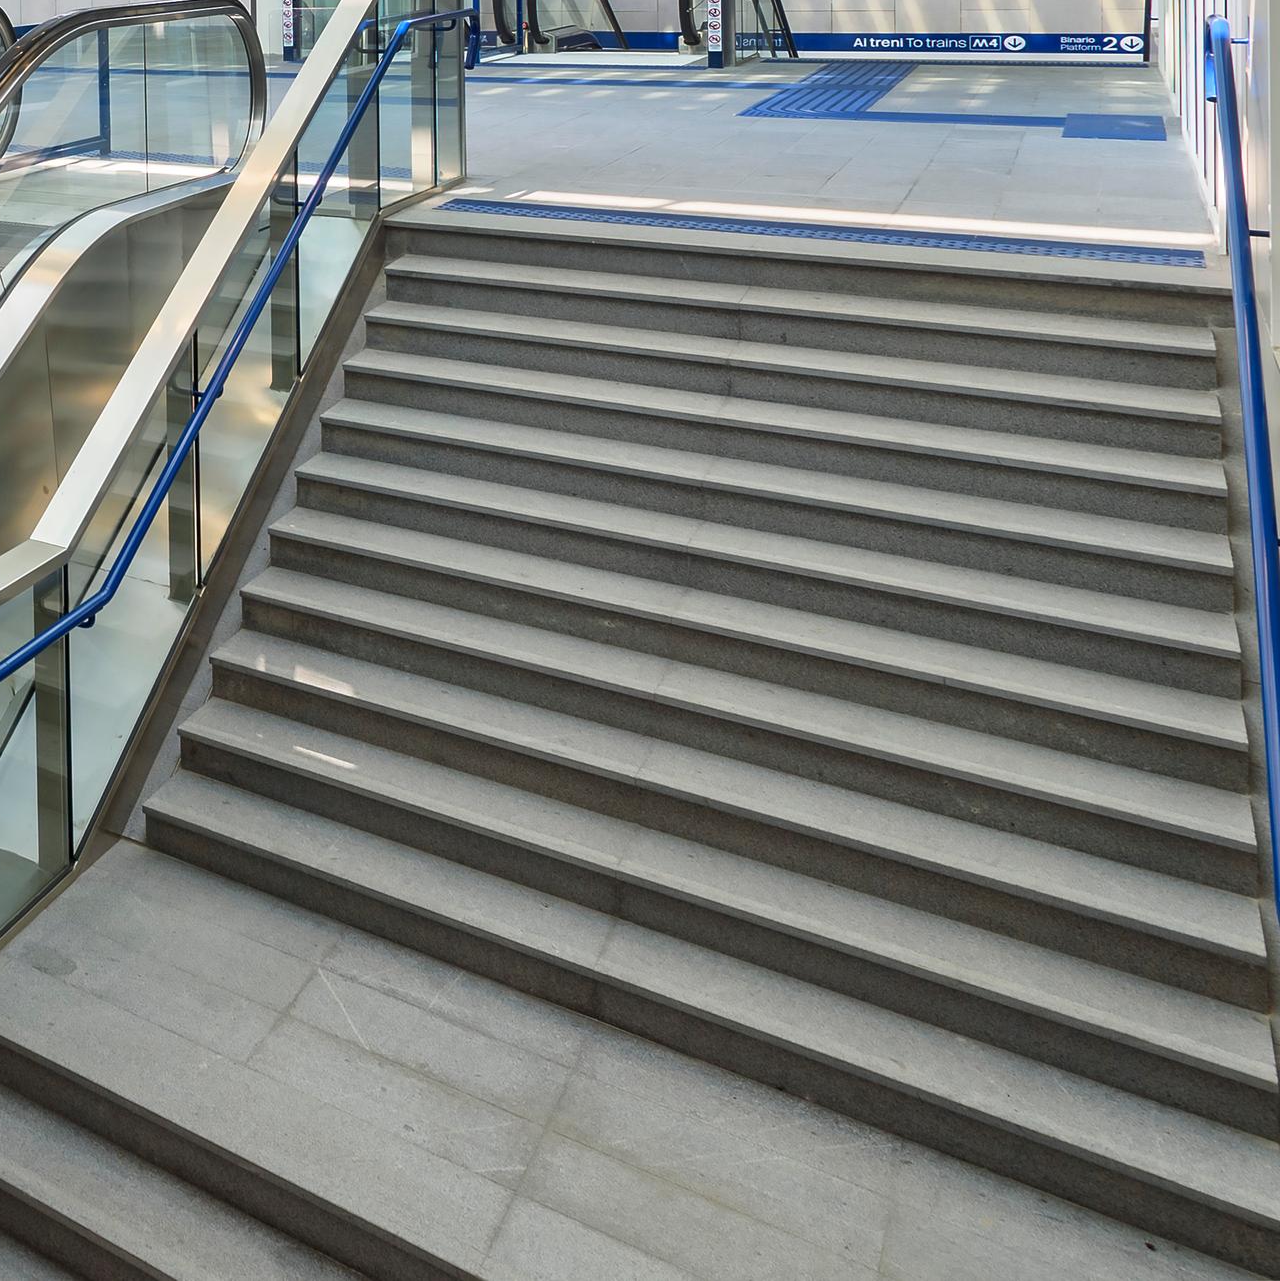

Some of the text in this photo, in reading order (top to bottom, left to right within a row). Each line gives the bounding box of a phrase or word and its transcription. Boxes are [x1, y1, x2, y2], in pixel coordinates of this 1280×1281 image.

[853, 37, 998, 48] Al treni To trains M4
[1060, 43, 1101, 51] Platform
[1102, 36, 1118, 51] 2
